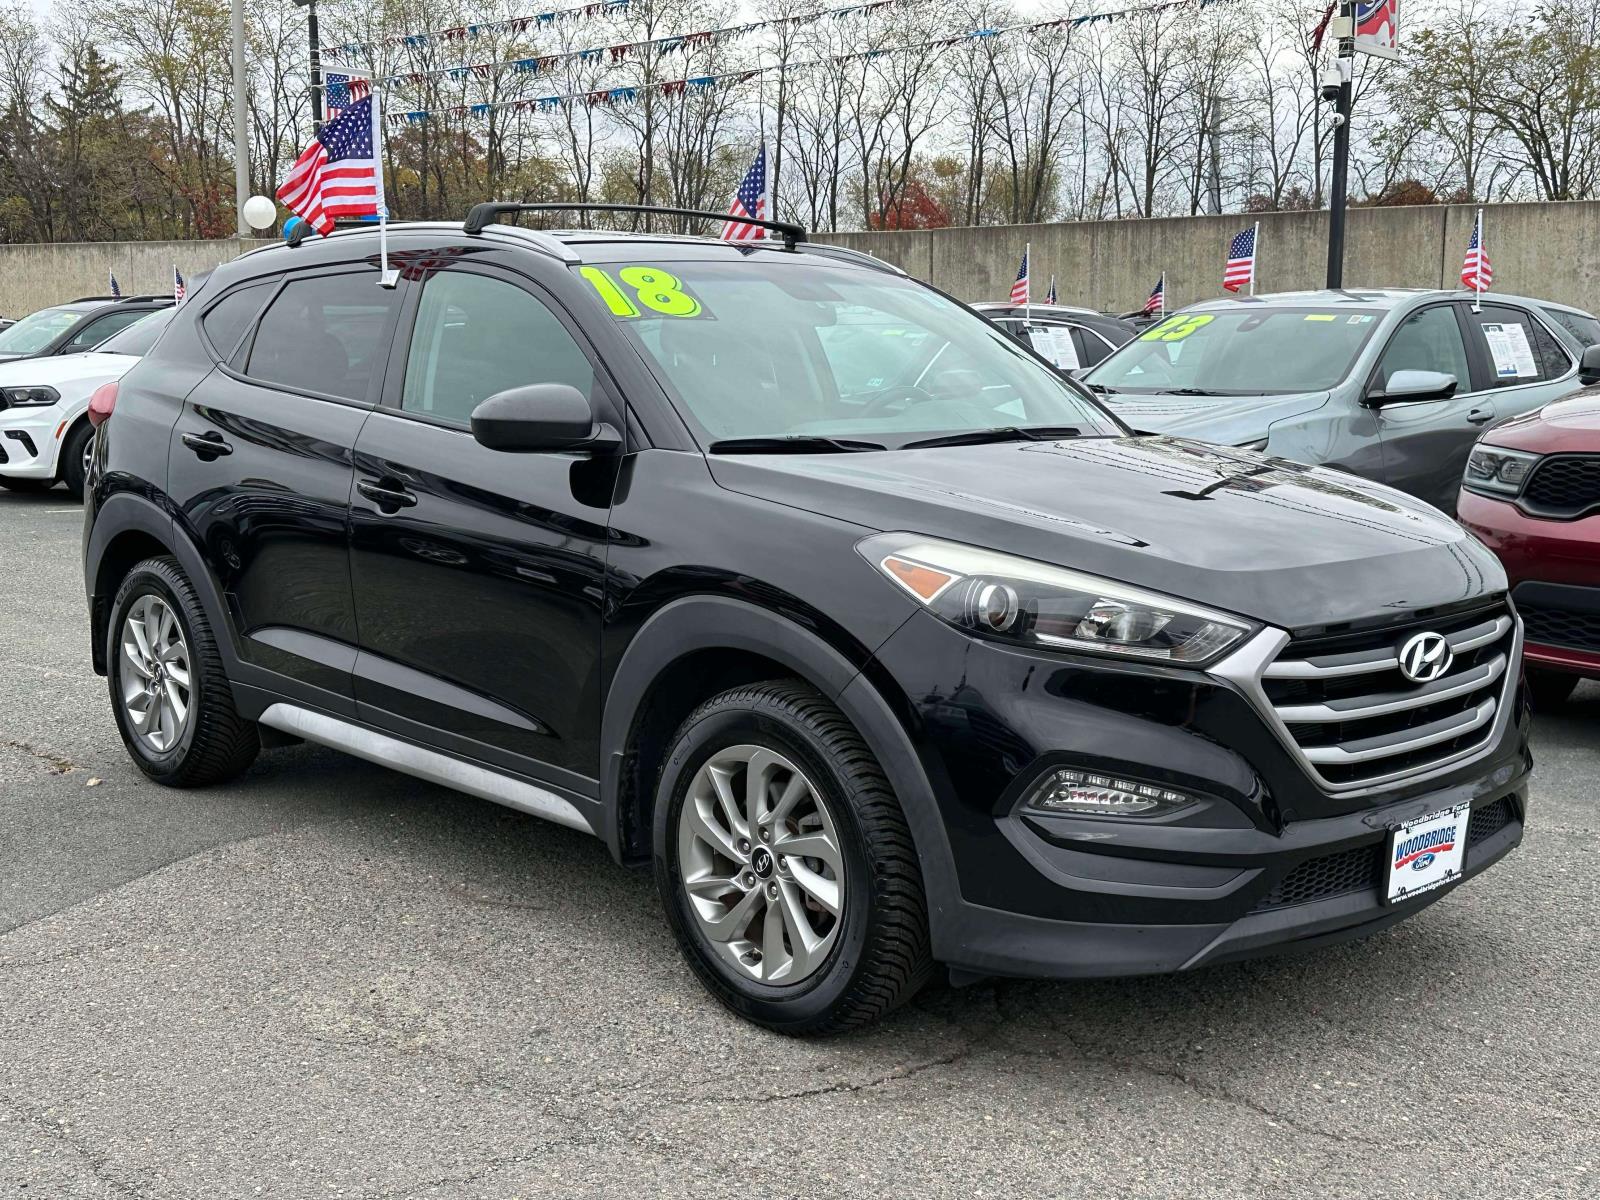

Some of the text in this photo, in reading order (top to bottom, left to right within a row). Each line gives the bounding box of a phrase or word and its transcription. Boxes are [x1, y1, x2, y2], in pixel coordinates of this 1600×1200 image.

[579, 266, 702, 318] 18
[1139, 314, 1216, 342] 23
[1400, 801, 1471, 830] Woodbridge Ford
[1395, 826, 1456, 861] WOODBRIDGE
[1391, 873, 1462, 903] www.woodbridgeford.com
